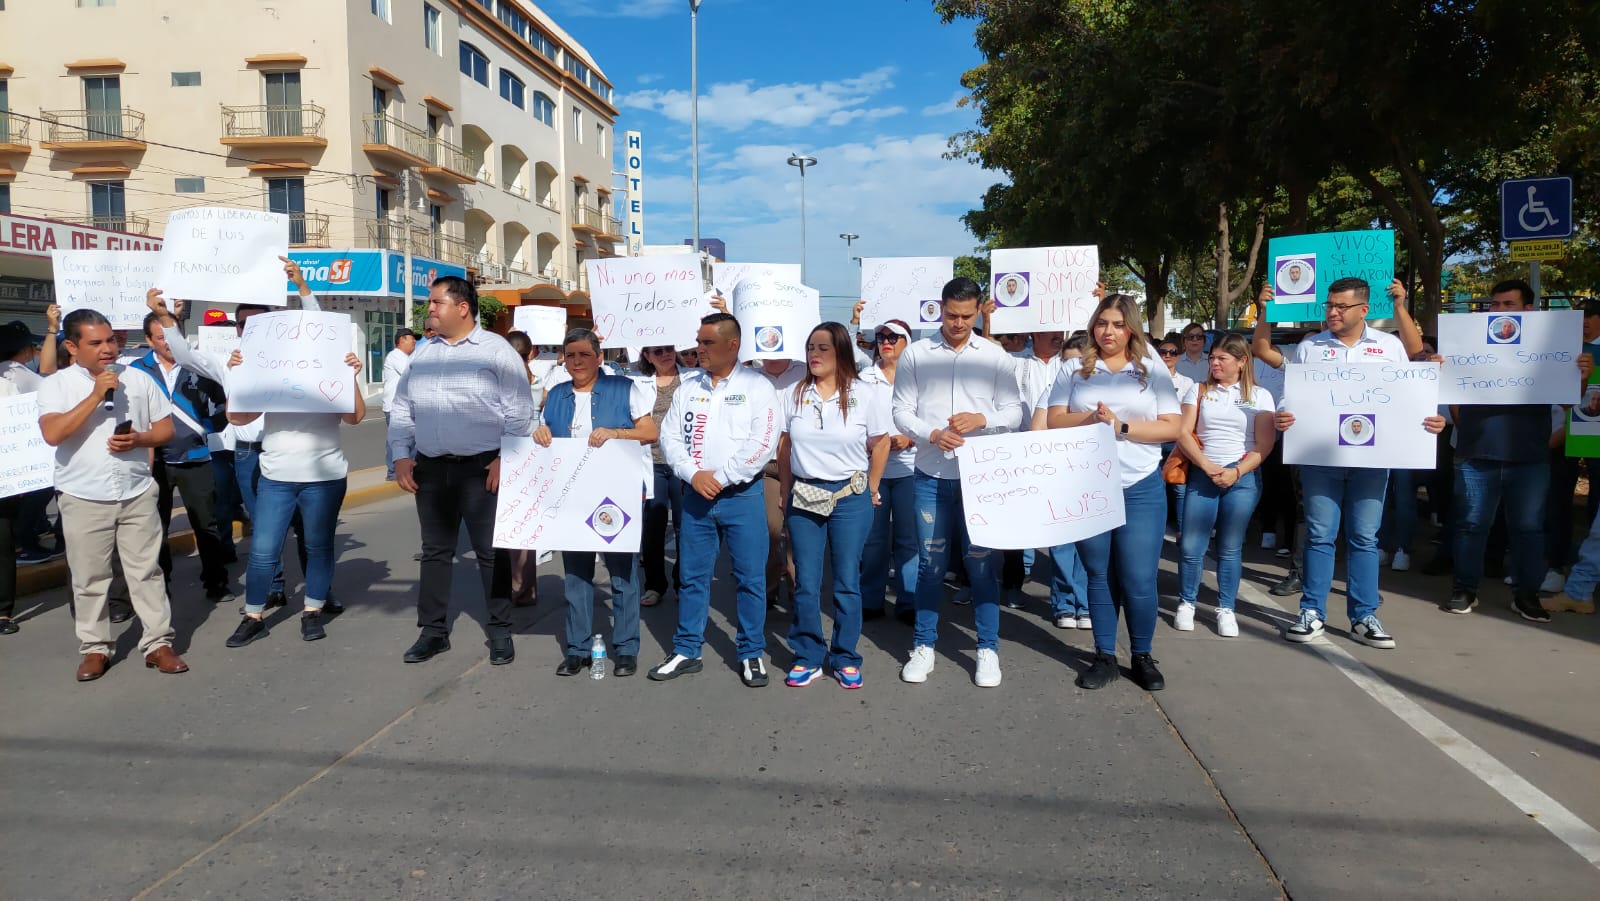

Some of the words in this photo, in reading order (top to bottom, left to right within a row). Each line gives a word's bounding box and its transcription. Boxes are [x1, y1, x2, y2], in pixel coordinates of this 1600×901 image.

[629, 136, 640, 235] HOTEL
[71, 230, 98, 250] DE
[192, 227, 207, 240] DE
[218, 228, 245, 241] LUIS
[1333, 234, 1389, 251] VIVOS
[173, 261, 240, 274] FRANCISCO
[1045, 248, 1096, 268] TODOS
[1331, 254, 1349, 266] SE
[1357, 252, 1384, 265] LOS
[596, 264, 615, 288] Ni
[624, 272, 656, 286] uno
[664, 269, 696, 282] mas
[1036, 270, 1096, 295] SOMOS
[619, 292, 675, 313] Todos
[680, 297, 698, 308] en
[1040, 297, 1090, 325] LUIS
[620, 318, 666, 339] Casa
[1447, 352, 1499, 367] Todos
[1516, 350, 1572, 364] Somos
[1303, 367, 1365, 382] Todos
[1381, 366, 1437, 382] Somos
[1456, 376, 1535, 391] Francisco
[968, 462, 1057, 485] exigimos
[976, 485, 1040, 506] regreso
